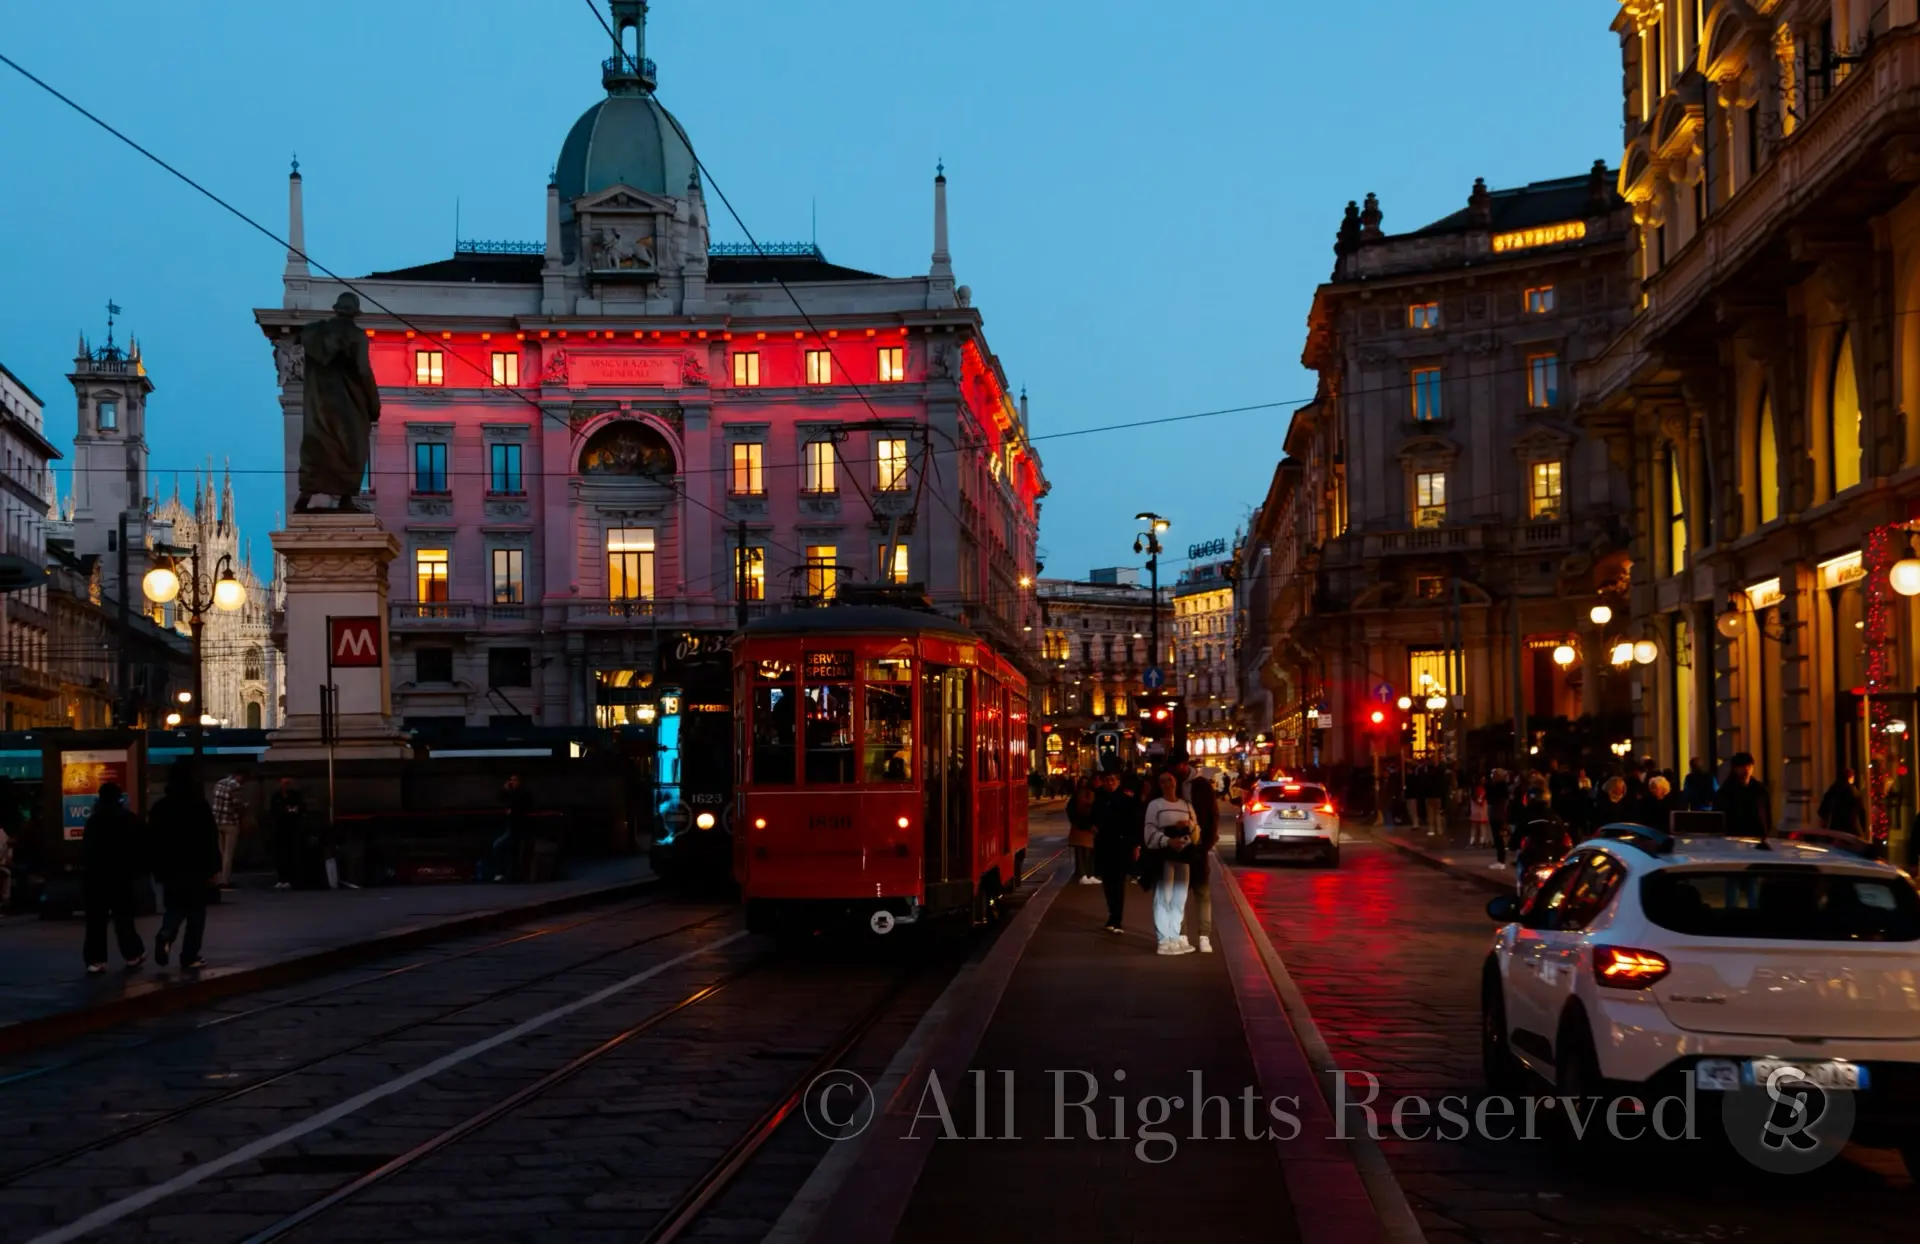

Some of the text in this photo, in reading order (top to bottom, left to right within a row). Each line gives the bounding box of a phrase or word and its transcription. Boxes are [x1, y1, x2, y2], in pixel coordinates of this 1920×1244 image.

[1492, 220, 1586, 254] STARBUCKS
[1188, 537, 1225, 560] GUCCI
[336, 628, 377, 656] M
[1528, 639, 1576, 649] STARBUKS
[660, 696, 679, 714] 19
[691, 793, 723, 804] 1625
[69, 806, 91, 818] WC
